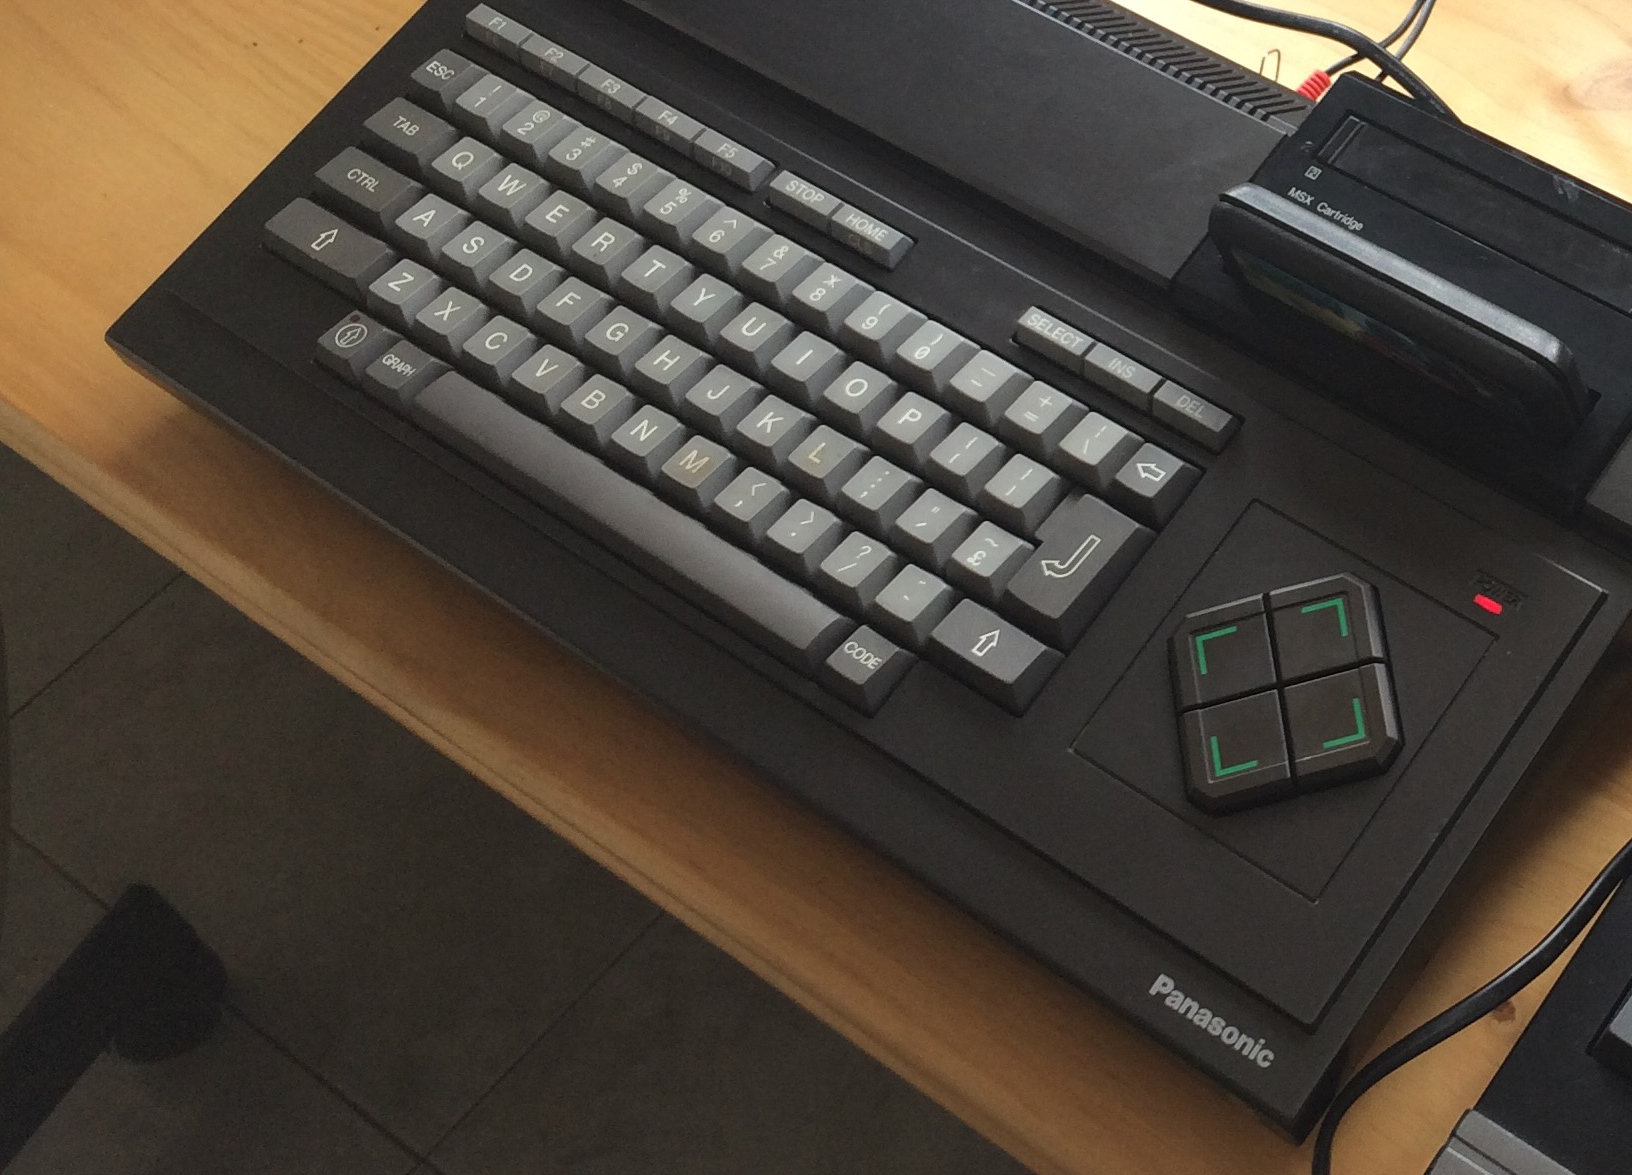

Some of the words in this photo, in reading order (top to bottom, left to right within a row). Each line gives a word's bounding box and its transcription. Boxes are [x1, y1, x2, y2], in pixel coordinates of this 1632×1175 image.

[488, 16, 507, 31] F1
[544, 47, 564, 63] F2
[426, 61, 455, 80] ESC
[601, 78, 621, 94] F3
[393, 115, 420, 137] TAB
[658, 110, 679, 126] F4
[517, 122, 534, 135] 2
[565, 149, 582, 161] 3
[716, 142, 738, 159] F5
[451, 151, 474, 170] Q
[347, 167, 380, 193] CTRL
[497, 174, 527, 196] W
[612, 176, 628, 188] 4
[785, 180, 825, 203] STOP
[545, 204, 569, 223] E
[659, 201, 677, 215] 5
[1287, 187, 1314, 205] MSX
[1316, 202, 1364, 231] Cartridge
[412, 209, 436, 227] A
[846, 213, 889, 242] HOME
[462, 236, 485, 254] S
[591, 231, 615, 252] R
[709, 229, 725, 243] 6
[509, 263, 533, 282] D
[643, 259, 666, 278] T
[759, 258, 776, 271] 7
[388, 272, 414, 291] Z
[555, 291, 582, 307] F
[693, 288, 715, 306] Y
[809, 287, 827, 301] 8
[434, 301, 461, 320] X
[605, 322, 629, 342] G
[741, 317, 766, 336] U
[861, 316, 879, 330] 9
[1027, 314, 1083, 349] SELECT
[484, 332, 508, 350] C
[381, 354, 416, 377] GRAPH
[653, 350, 680, 371] H
[795, 349, 813, 365] I
[535, 358, 558, 377] V
[1108, 358, 1136, 378] INS
[707, 384, 730, 400] J
[845, 378, 868, 397] O
[581, 389, 606, 410] B
[1176, 394, 1205, 419] DEL
[756, 411, 784, 433] K
[897, 408, 922, 424] P
[630, 419, 658, 442] N
[679, 449, 710, 473] M
[808, 442, 826, 463] L
[844, 641, 883, 670] CODE
[1149, 973, 1275, 1068] Panasonic
